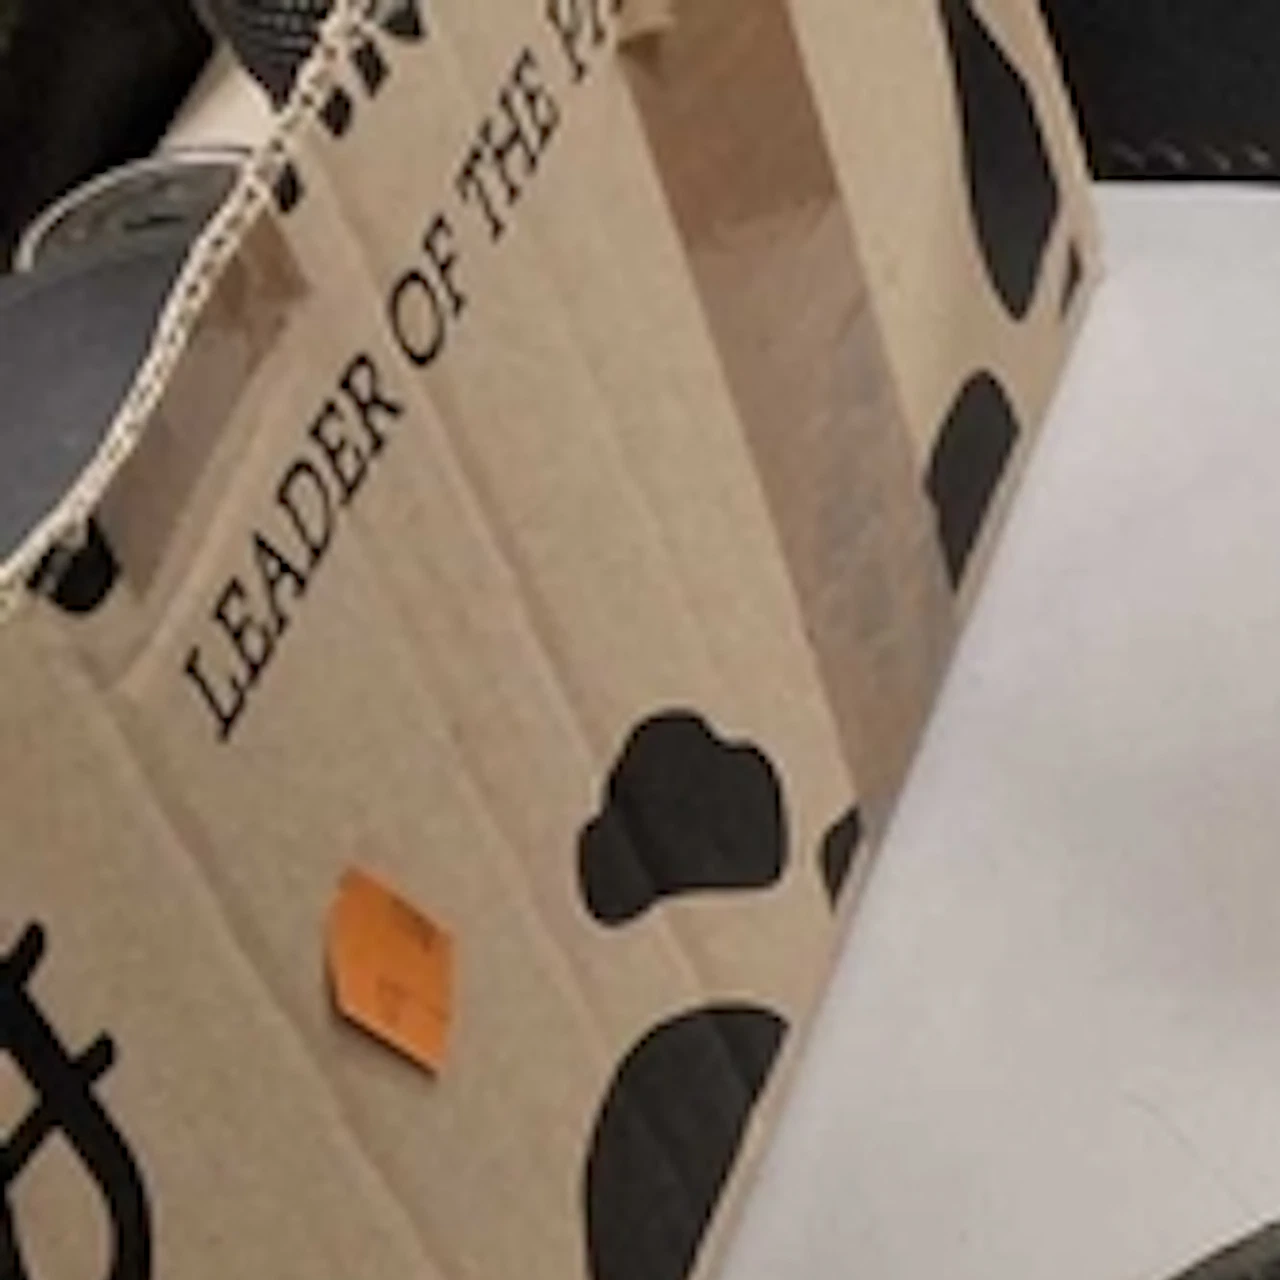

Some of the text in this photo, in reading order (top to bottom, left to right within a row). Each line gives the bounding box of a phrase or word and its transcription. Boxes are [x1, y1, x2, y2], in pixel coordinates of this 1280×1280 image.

[182, 354, 406, 743] LEADER
[388, 214, 472, 370] OF
[455, 45, 561, 243] THE
